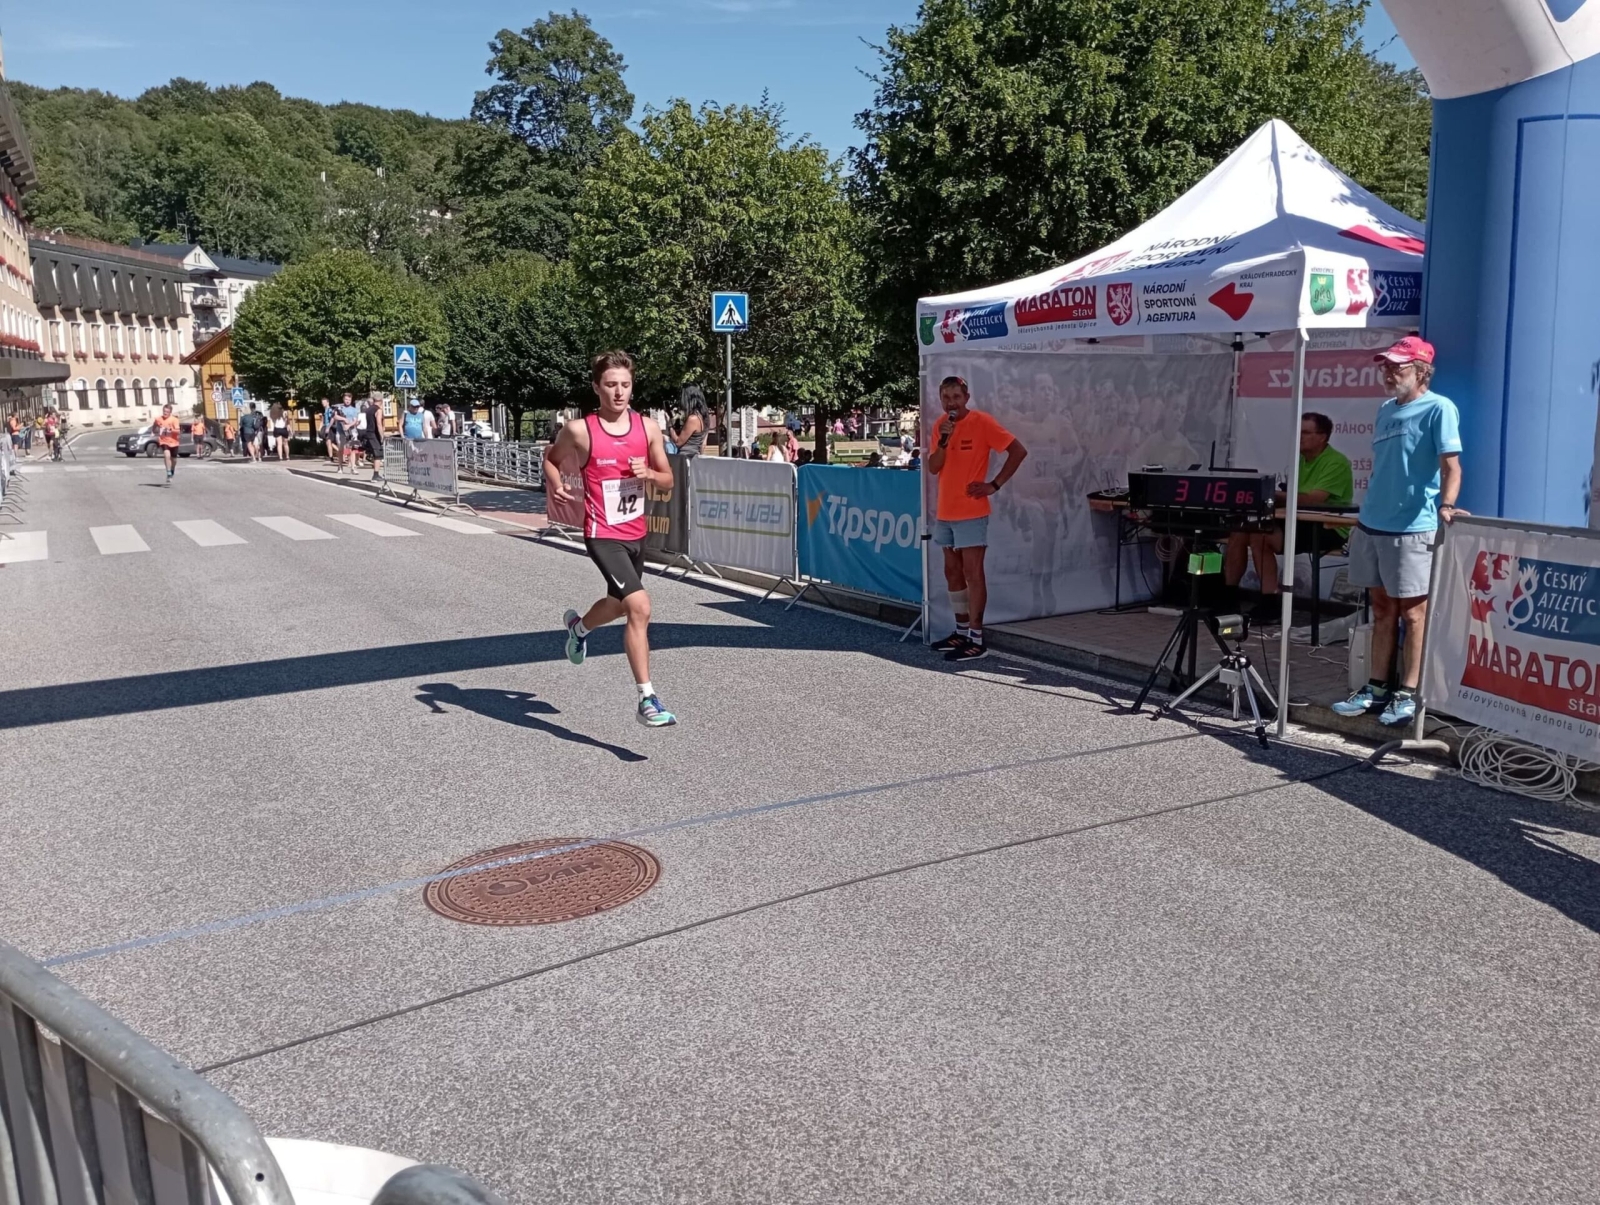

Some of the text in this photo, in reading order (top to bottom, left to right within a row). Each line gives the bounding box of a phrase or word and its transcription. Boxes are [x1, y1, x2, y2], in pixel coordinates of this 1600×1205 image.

[1143, 279, 1187, 294] NÁRODNÍ
[1014, 285, 1096, 314] MARATON
[1144, 294, 1197, 309] SPORTOVNÍ
[1387, 301, 1408, 311] SVAZ
[968, 313, 1004, 327] ATLETICKÝ
[1072, 308, 1093, 317] stav
[1145, 311, 1196, 323] AGENTURA
[970, 327, 989, 337] SVAZ
[1176, 480, 1189, 501] 3
[1204, 481, 1228, 503] 16
[617, 494, 638, 515] 42
[733, 503, 743, 521] 4
[1543, 567, 1588, 592] ČESKÝ
[1532, 612, 1569, 634] SVAZ
[1468, 634, 1600, 695] MARATO
[1568, 697, 1600, 717] sta
